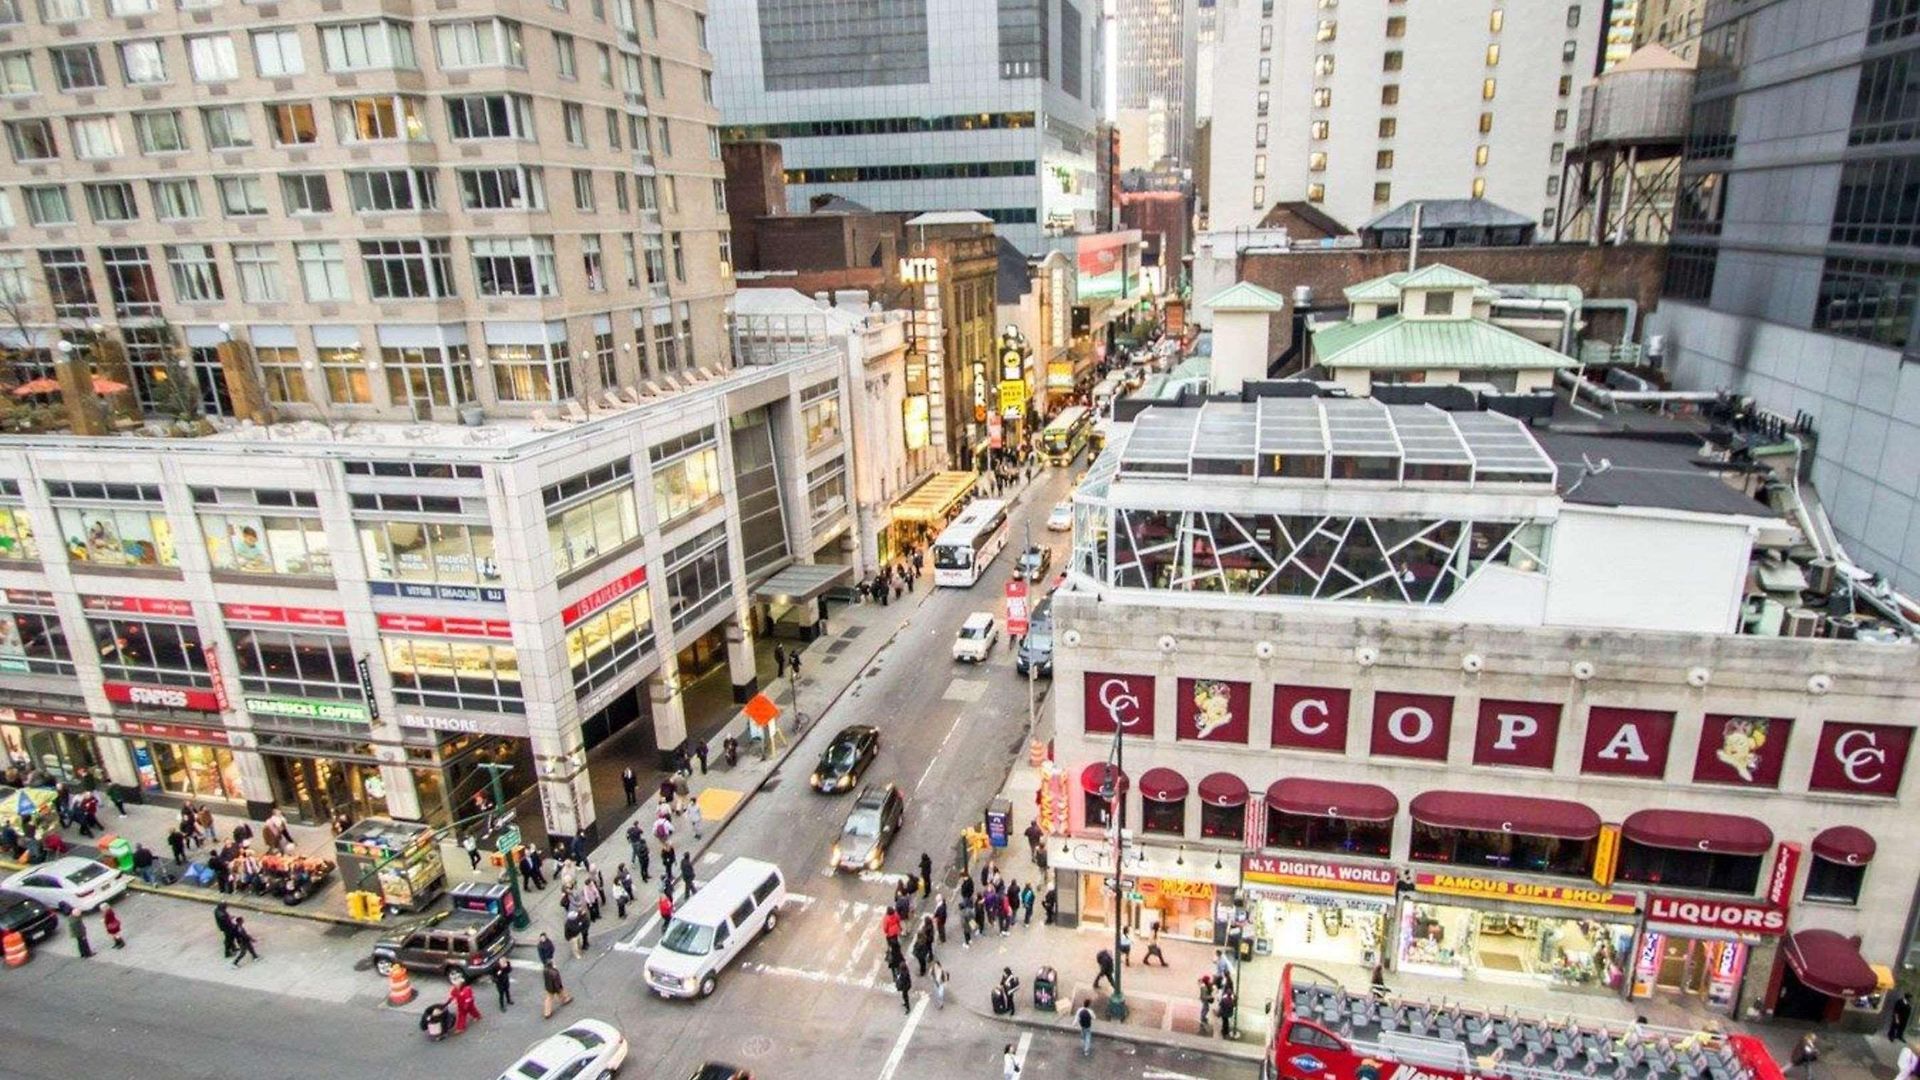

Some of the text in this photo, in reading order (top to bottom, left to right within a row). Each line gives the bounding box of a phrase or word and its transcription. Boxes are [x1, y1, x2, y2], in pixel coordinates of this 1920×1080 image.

[487, 590, 502, 600] BJJ
[405, 714, 477, 730] BILTMORE
[1158, 790, 1166, 799] C
[1218, 795, 1227, 804] C
[1328, 806, 1338, 816] C
[1502, 822, 1512, 832] C
[1699, 840, 1709, 850] C
[1847, 854, 1857, 864] C
[1249, 858, 1391, 883] N.Y. DIGITAL WORLD
[1433, 874, 1614, 904] FAMOUS GIFT SHOP
[1652, 899, 1784, 928] LIQUORS
